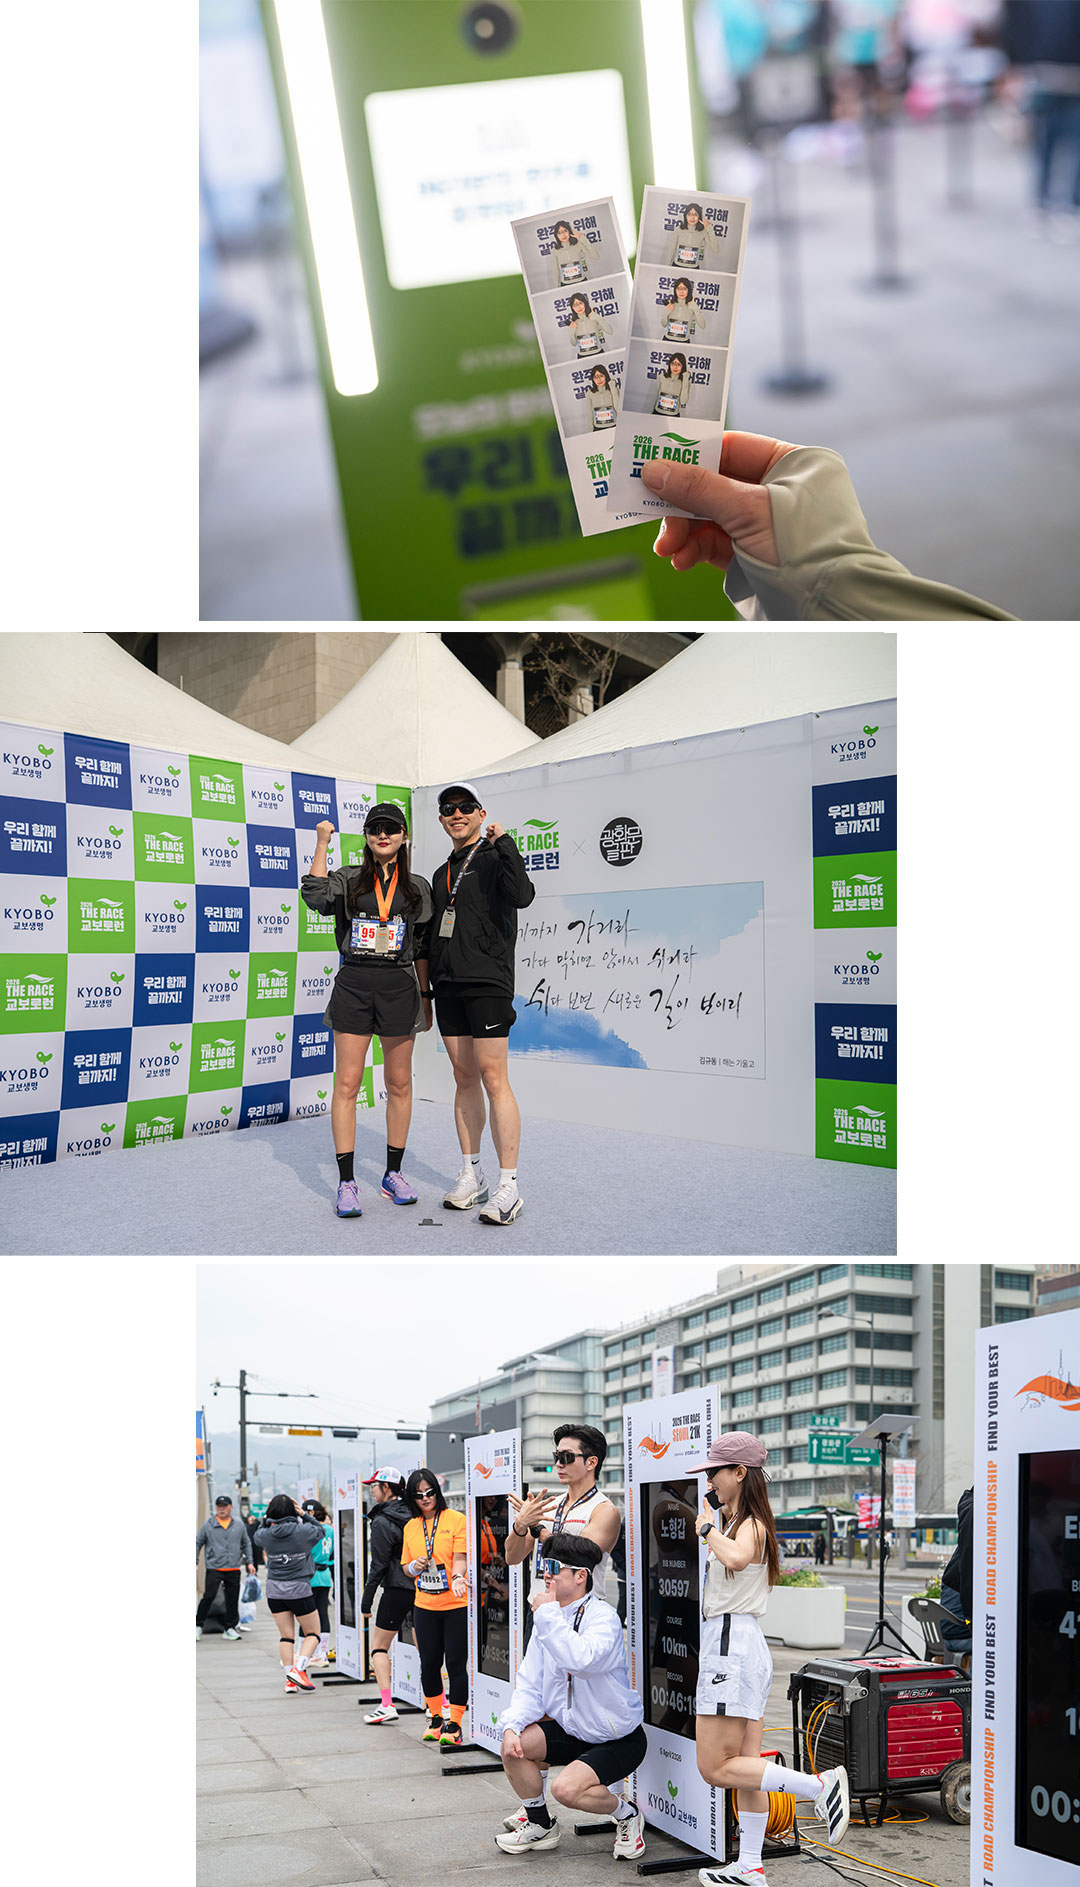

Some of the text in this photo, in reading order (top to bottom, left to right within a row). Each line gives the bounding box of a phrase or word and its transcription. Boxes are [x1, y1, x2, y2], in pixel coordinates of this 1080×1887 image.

[705, 207, 729, 223] 위해
[573, 216, 597, 233] 위해
[591, 287, 615, 304] 위해
[697, 281, 720, 297] 위해
[688, 356, 711, 370] 위해
[633, 435, 653, 444] 2026
[585, 453, 604, 465] 2026
[633, 443, 700, 465] THE RACE
[831, 738, 876, 754] KYOBO
[3, 753, 52, 770] KYOBO
[838, 751, 867, 762] 교보생명
[75, 756, 122, 775] 우리 함께
[12, 767, 42, 779] 교보생명
[81, 771, 119, 788] 끝까지!
[140, 774, 180, 789] KYOBO
[200, 781, 235, 794] THE RACE
[147, 786, 172, 797] 교보생명
[201, 790, 236, 805] 교보로런
[251, 790, 284, 802] KYOBO
[299, 790, 331, 804] 우리 함께
[343, 802, 370, 812] KYOBO
[828, 800, 885, 819] 우리 함께
[4, 820, 57, 839] 우리 함께
[834, 817, 880, 835] 끝까지!
[77, 836, 122, 850] KYOBO
[527, 832, 559, 851] RACE
[600, 825, 642, 847] 광화문
[10, 837, 53, 854] 끝까지!
[145, 840, 184, 853] THE RACE
[255, 844, 291, 858] 우리 함께
[85, 849, 113, 860] 교보생명
[145, 851, 185, 864] 교보로런
[202, 847, 239, 859] KYOBO
[260, 857, 289, 870] 끝까지!
[832, 884, 883, 899] THE RACE
[832, 898, 884, 912] 교보로런
[4, 908, 54, 920] KYOBO
[81, 907, 124, 919] THE RACE
[144, 912, 185, 923] KYOBO
[204, 906, 243, 919] 우리 함께
[13, 922, 44, 931] 교보생명
[81, 920, 125, 932] 교보로런
[208, 920, 240, 933] 끝까지!
[257, 915, 290, 925] KYOBO
[152, 925, 177, 934] 교보생명
[361, 927, 395, 941] 955
[557, 950, 595, 980] 막히면
[602, 948, 640, 969] 앉아서
[647, 944, 699, 984] 쉬거라
[833, 965, 880, 975] KYOBO
[143, 976, 187, 990] 우리 함께
[202, 982, 239, 993] KYOBO
[257, 976, 288, 988] THE RACE
[841, 977, 870, 985] 교보생명
[6, 984, 54, 997] THE RACE
[77, 986, 122, 998] KYOBO
[5, 997, 54, 1012] 교보로런
[84, 999, 113, 1009] 교보생명
[148, 991, 182, 1005] 끝까지!
[603, 988, 642, 1014] 새로운
[649, 974, 689, 1030] 길이
[700, 992, 743, 1020] 보이리
[298, 1031, 329, 1045] 우리 함께
[831, 1025, 888, 1043] 우리 함께
[201, 1046, 236, 1059] THE RACE
[251, 1044, 284, 1056] KYOBO
[837, 1043, 883, 1060] 끝까지!
[73, 1052, 122, 1069] 우리 함께
[139, 1055, 180, 1068] KYOBO
[200, 1057, 235, 1072] 교보로런
[0, 1067, 49, 1082] KYOBO
[78, 1068, 117, 1085] 끝까지!
[145, 1068, 171, 1079] 교보생명
[7, 1082, 38, 1093] 교보생명
[247, 1102, 284, 1118] 우리 함께
[296, 1102, 327, 1116] KYOBO
[192, 1118, 229, 1133] KYOBO
[834, 1115, 886, 1133] THE RACE
[135, 1124, 174, 1139] THE RACE
[67, 1136, 112, 1153] KYOBO
[834, 1130, 886, 1149] 교보로런
[988, 1345, 999, 1451] FIND YOUR BEST
[672, 1425, 700, 1443] SEOUL 21K
[660, 1517, 686, 1540] 노형갑
[986, 1461, 998, 1606] ROAD CHAMPIONSHIP
[669, 1560, 686, 1569] NUMBER
[658, 1577, 690, 1598] 30597
[661, 1636, 688, 1658] 10km
[984, 1614, 996, 1721] FIND YOUR BEST
[666, 1671, 684, 1683] RECORD
[983, 1728, 995, 1832] CHAMPIONSHIP
[647, 1792, 677, 1819] KYOBO
[983, 1834, 994, 1872] ROAD
